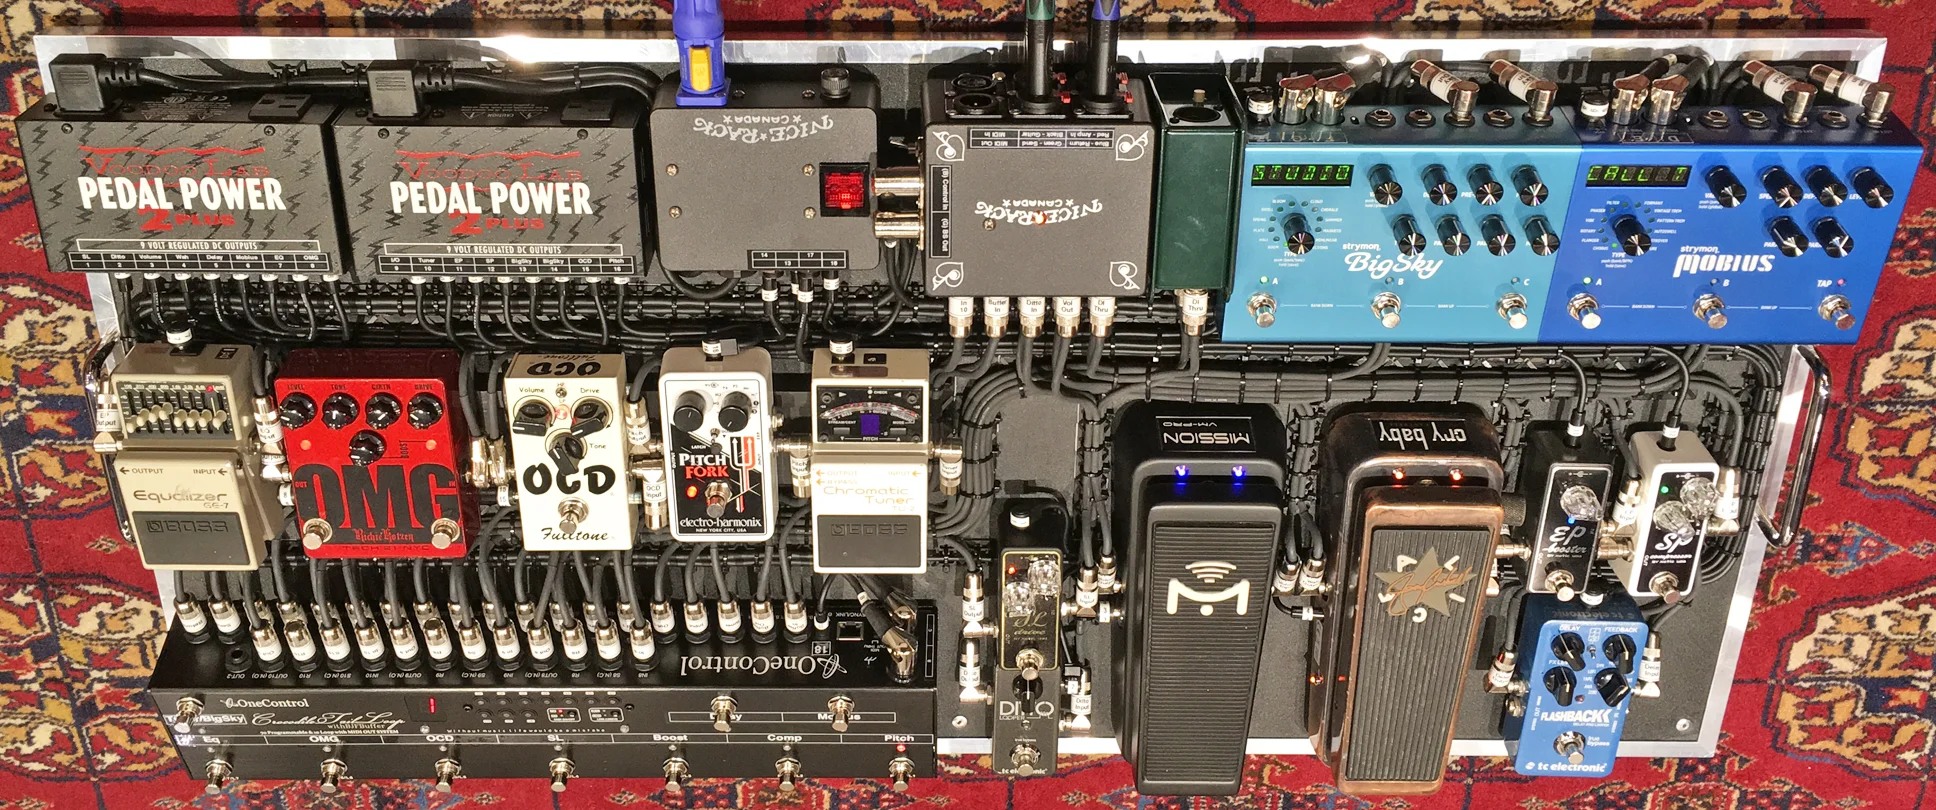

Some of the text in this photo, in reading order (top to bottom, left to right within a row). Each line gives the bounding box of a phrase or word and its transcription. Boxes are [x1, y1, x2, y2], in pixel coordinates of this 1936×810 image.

[735, 115, 789, 124] CANADA
[693, 117, 759, 144] RACK
[1253, 165, 1350, 181] STUDIO
[1587, 166, 1649, 182] CALL
[78, 177, 287, 211] PEDAL POWER
[390, 181, 593, 215] PEDAL POWER
[138, 208, 235, 231] 2 PLUS
[448, 210, 545, 235] 2 PLUS
[942, 229, 949, 239] BS
[141, 241, 258, 251] 9 VOLT REGULATED DC OUTPUTS
[447, 246, 562, 255] 9 VOLT REGULATED DC OUTPUTS
[1342, 244, 1380, 252] strymon
[1680, 246, 1719, 254] strymon
[1345, 252, 1443, 280] BigSky
[1673, 254, 1775, 278] MOBIUS
[1817, 279, 1832, 287] TAP
[527, 362, 602, 376] OCD
[1163, 432, 1250, 445] MISSION
[1379, 421, 1467, 450] cry baby
[680, 453, 727, 466] PITCH
[685, 466, 729, 478] FORK
[523, 462, 616, 495] OCD
[132, 489, 228, 503] Equalizer
[293, 463, 460, 529] OMG
[823, 486, 909, 495] Chromatic
[864, 495, 914, 505] Tuner
[680, 517, 762, 528] electro-harmonix
[541, 527, 609, 541] Fulltone
[1549, 526, 1587, 546] EP
[1542, 543, 1587, 554] booster
[814, 644, 828, 654] 18
[681, 656, 817, 676] OneControl
[237, 698, 309, 708] OneControl
[1541, 709, 1612, 723] FLASHBACK
[203, 736, 221, 744] Eq
[426, 734, 454, 742] OCD
[547, 734, 565, 742] SL
[767, 734, 802, 743] Comp
[885, 734, 915, 742] Pitch
[1537, 762, 1606, 773] tc electronic
